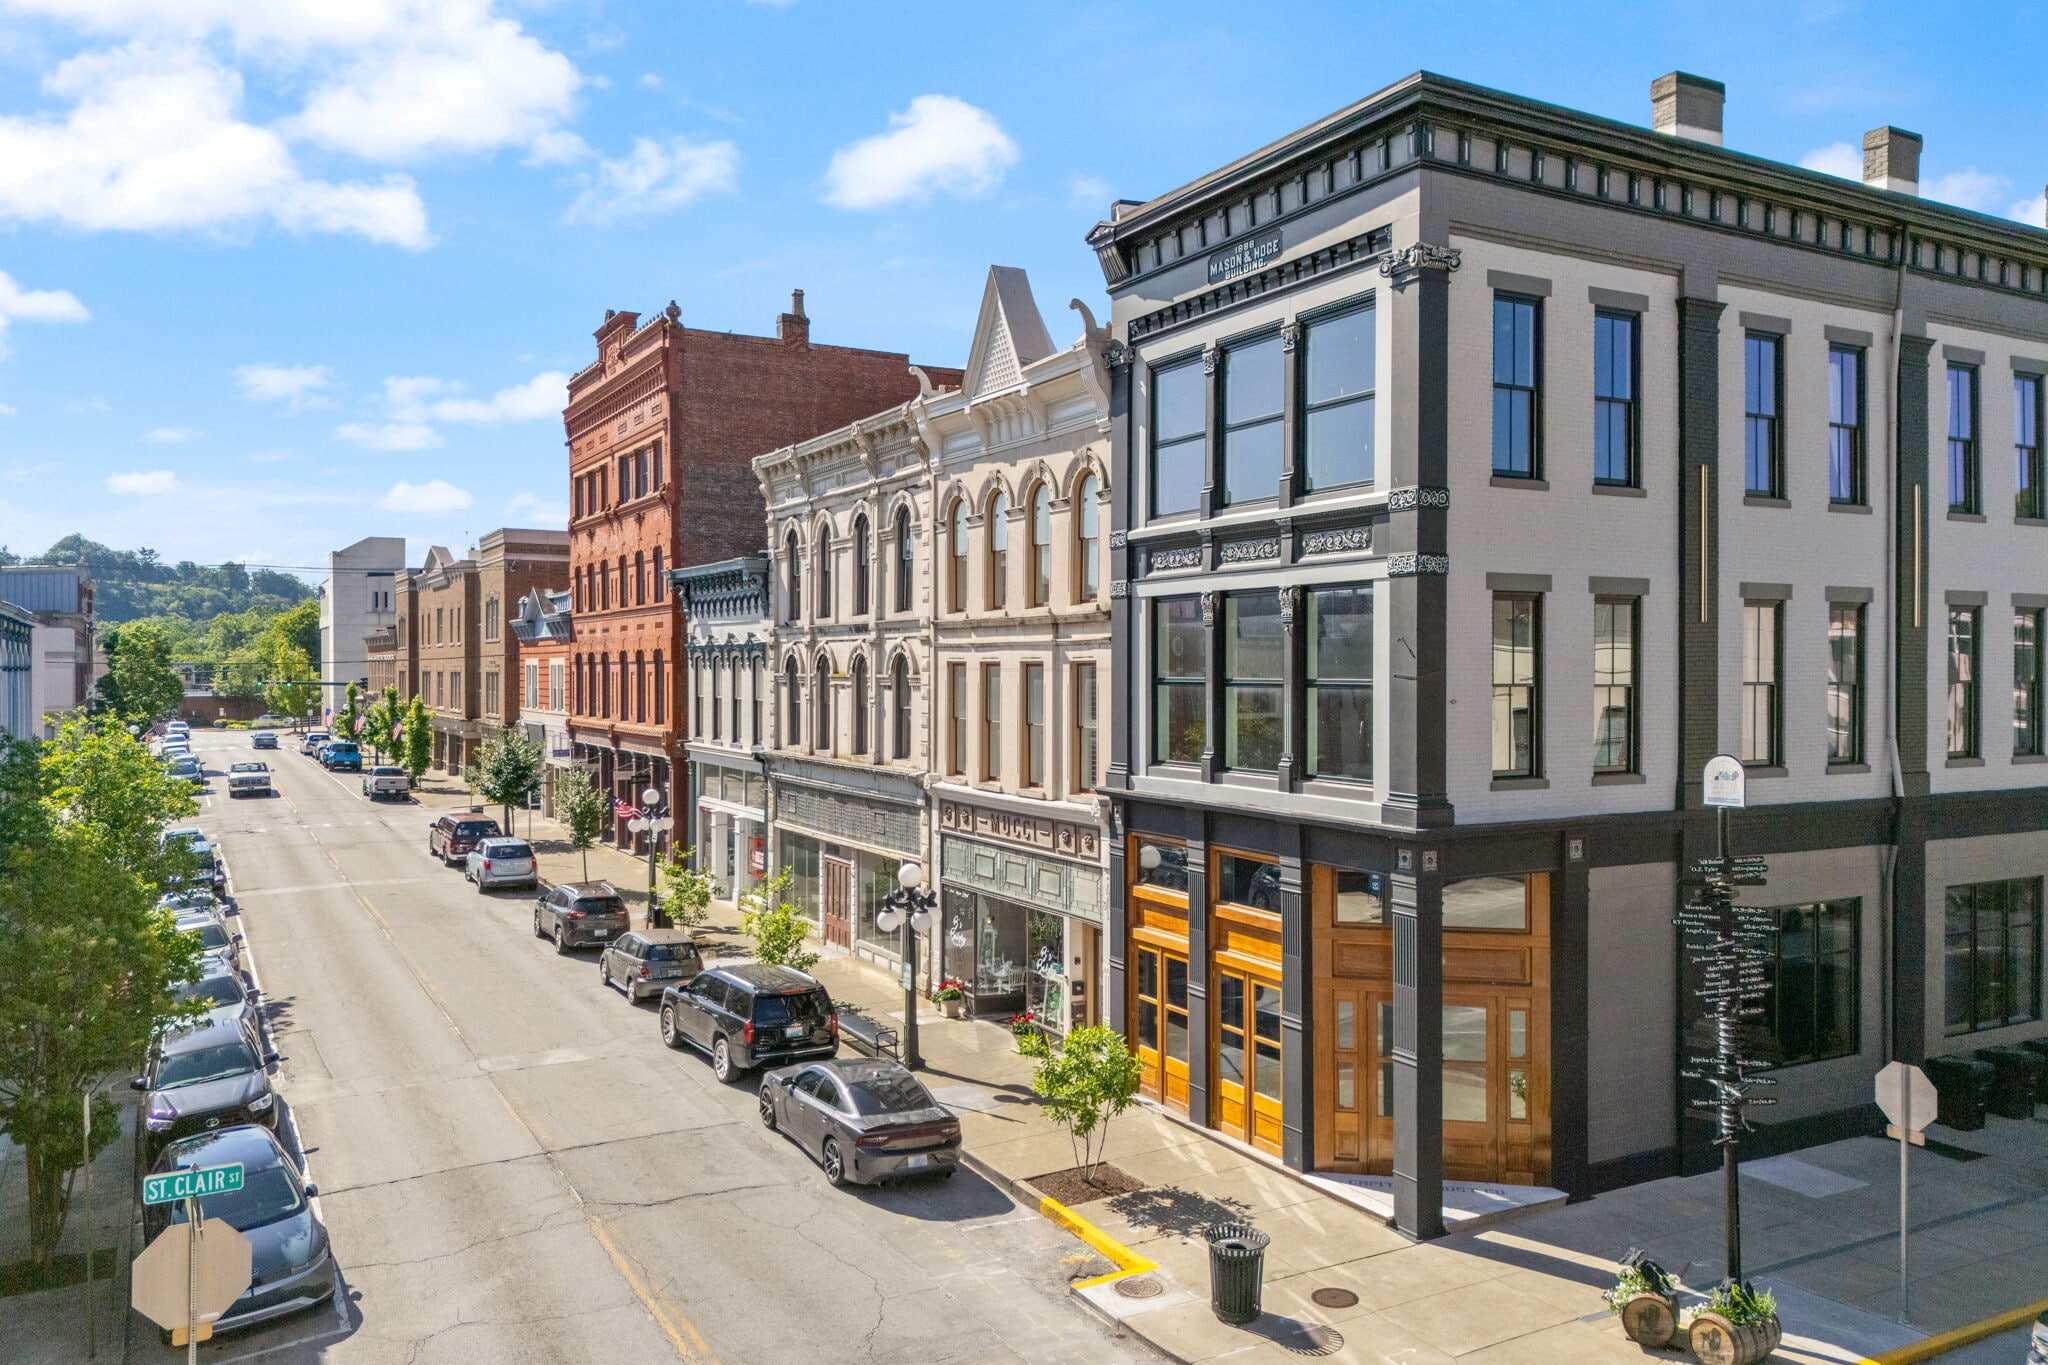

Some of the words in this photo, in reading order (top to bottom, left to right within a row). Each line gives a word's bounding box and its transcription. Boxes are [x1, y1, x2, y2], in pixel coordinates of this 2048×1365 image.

[1234, 240, 1255, 255] 1888
[1210, 252, 1241, 277] MASON
[1243, 250, 1253, 263] &
[990, 812, 1038, 842] MUCCI
[148, 1179, 172, 1200] ST.
[174, 1170, 226, 1196] CLAIR
[229, 1171, 240, 1183] ST
